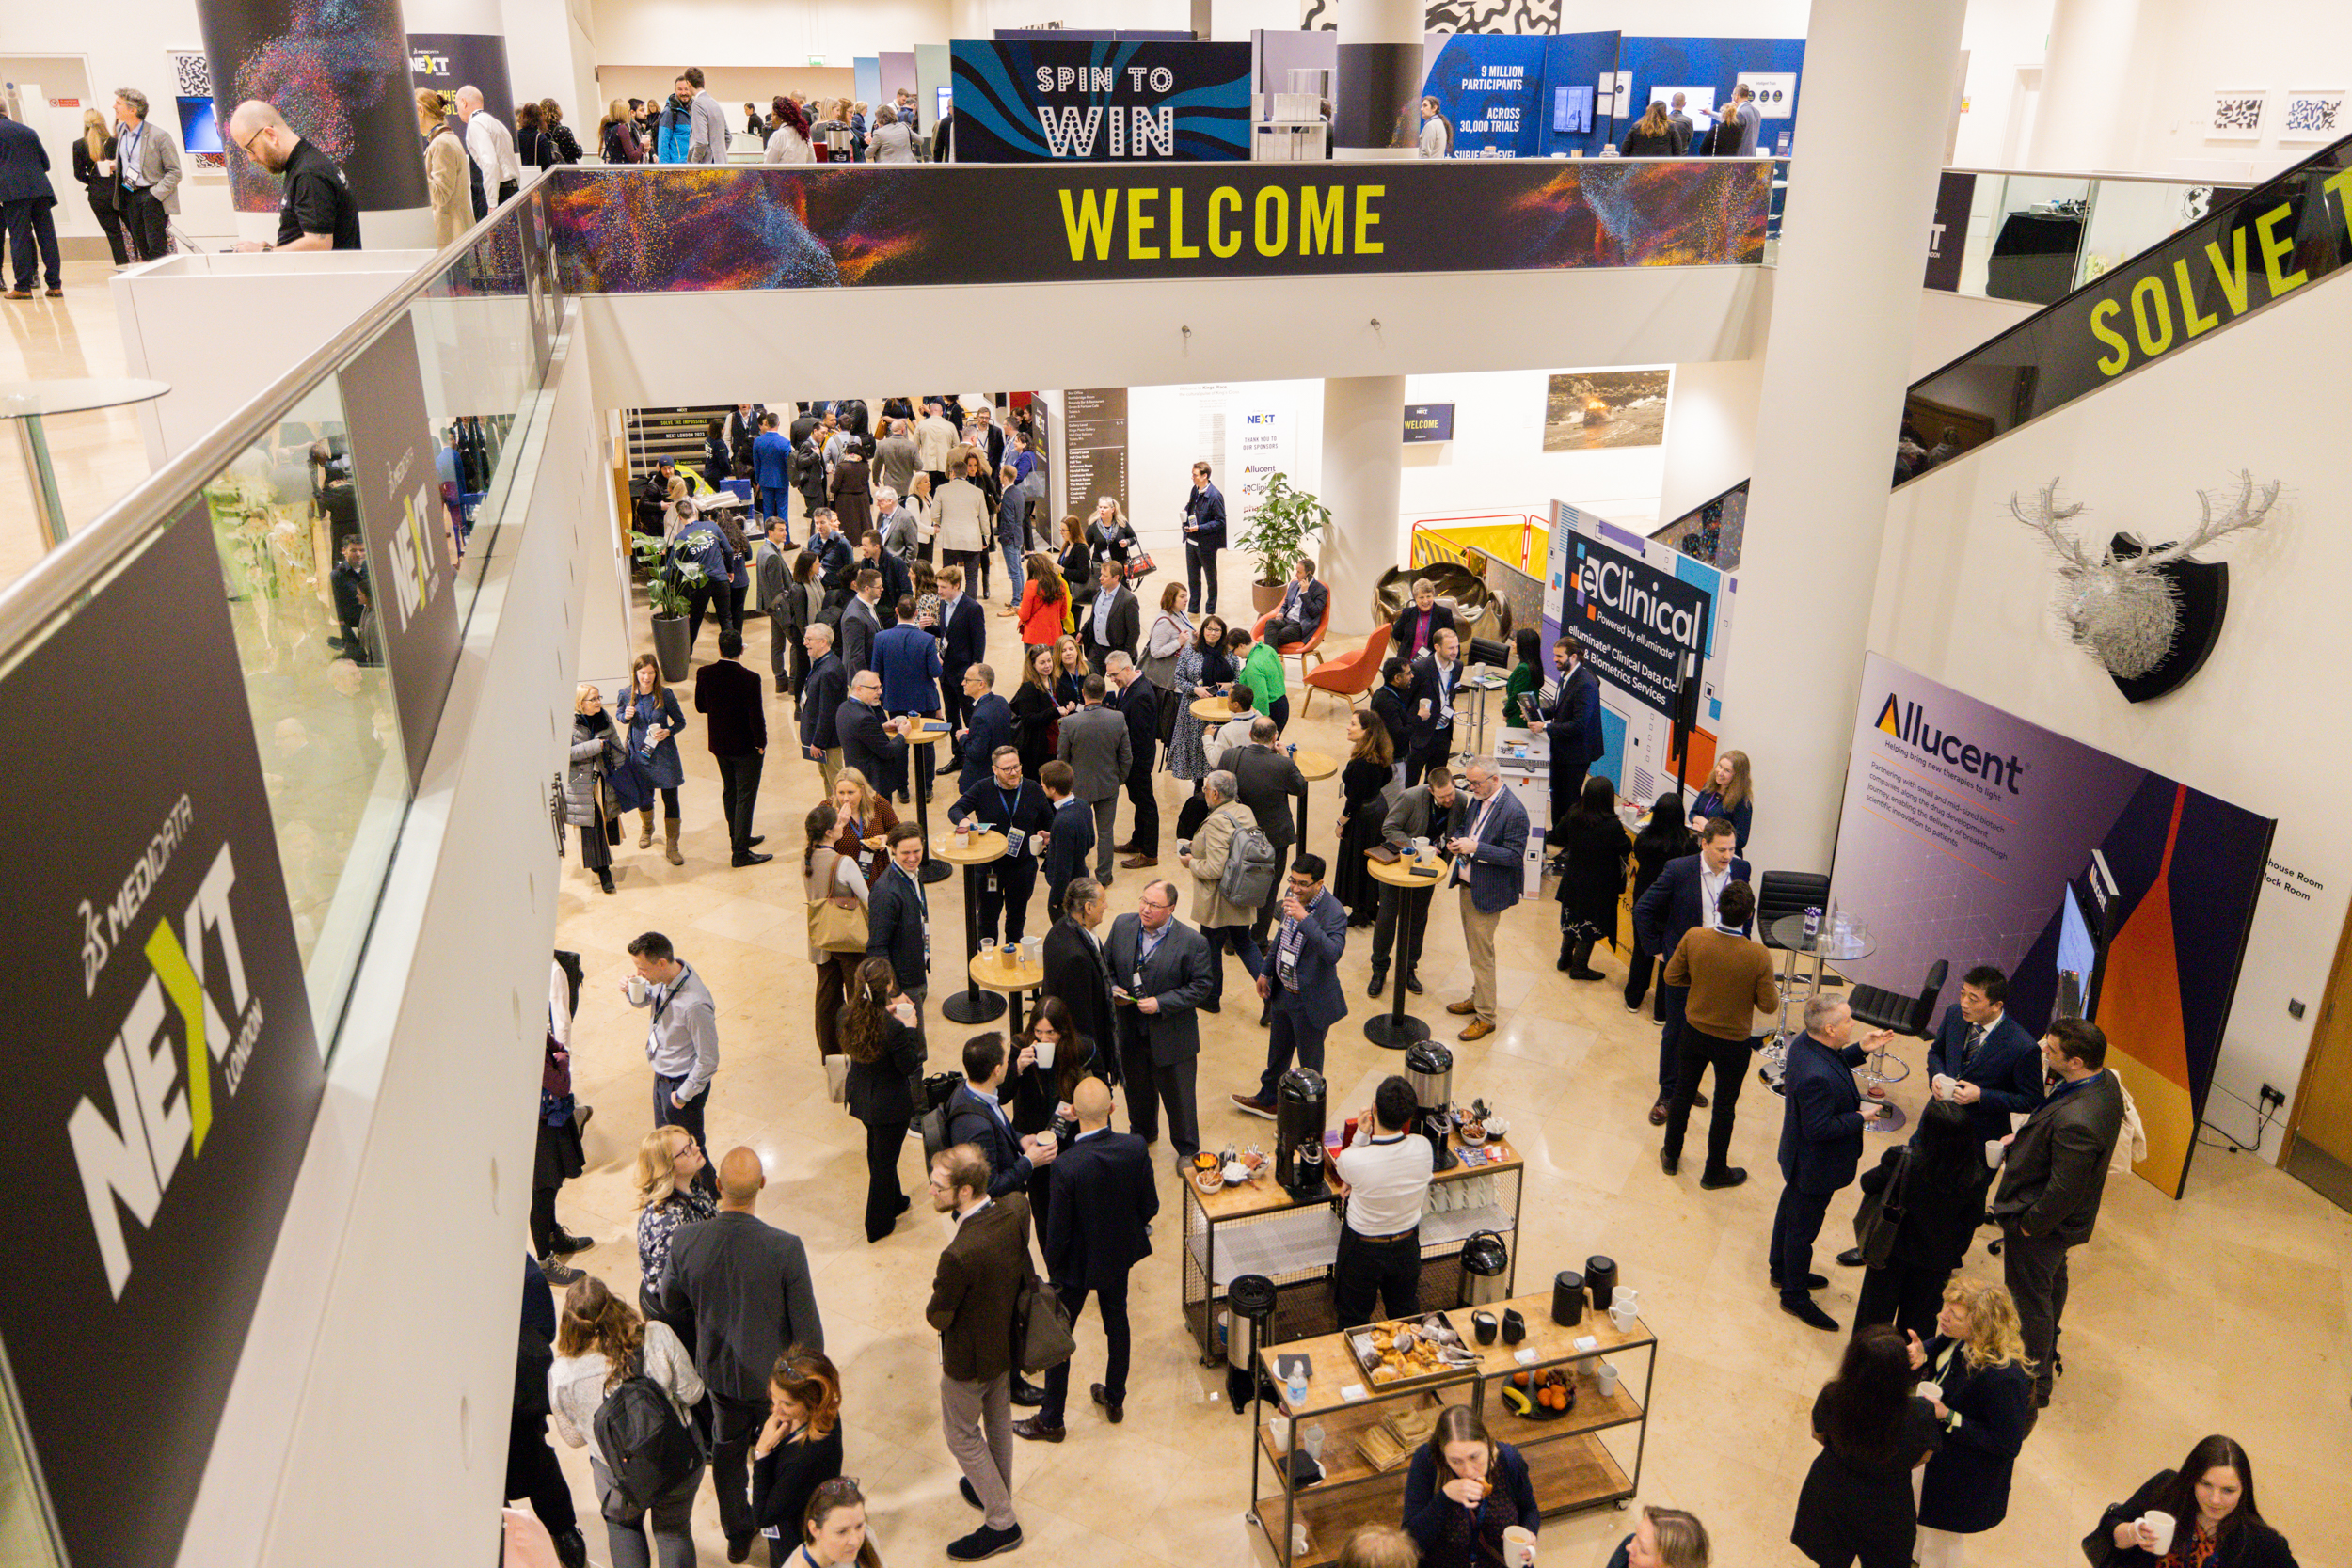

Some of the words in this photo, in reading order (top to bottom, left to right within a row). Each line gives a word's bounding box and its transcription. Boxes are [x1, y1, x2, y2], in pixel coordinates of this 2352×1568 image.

[409, 55, 449, 74] NEXT
[1036, 66, 1113, 92] SPIN
[1128, 67, 1173, 92] TO
[1462, 79, 1523, 90] PARTICIPANTS
[1481, 66, 1487, 77] 9
[1489, 66, 1524, 77] MILLION
[1037, 106, 1174, 157] WIN
[1460, 121, 1489, 134] 30,000
[1491, 121, 1520, 132] TRIALS
[1487, 108, 1521, 119] ACROSS
[1058, 185, 1385, 261] WELCOME
[2090, 202, 2308, 376] SOLVE
[1247, 414, 1275, 424] NEXT
[1404, 420, 1438, 429] WELCOME
[389, 483, 435, 634] NEXT
[690, 539, 715, 555] STAFF
[1581, 558, 1702, 649] eClinical
[1597, 611, 1626, 635] Powered
[1626, 626, 1636, 642] by
[1584, 649, 1589, 660] &
[1590, 652, 1631, 685] Biometrics
[1632, 677, 1666, 705] Services
[1612, 648, 1640, 673] Clinical
[1641, 664, 1661, 685] Data
[1885, 740, 1908, 758] Helping
[1910, 752, 1926, 767] bring
[1928, 762, 1942, 773] new
[1943, 768, 1974, 789] therapies
[1976, 784, 1983, 793] to
[1984, 788, 2001, 803] light
[1866, 794, 1891, 812] scientific
[1892, 808, 1924, 828] innovation
[1925, 824, 1931, 832] to
[1932, 829, 1958, 847] patients
[1867, 783, 1890, 800] journey,
[1891, 796, 1916, 814] enabling
[1918, 809, 1928, 819] the
[1929, 814, 1953, 833] delivery
[1963, 830, 2008, 860] breakthrough
[1869, 773, 1900, 793] companies
[1901, 789, 1918, 803] along
[1919, 797, 1929, 808] the
[1930, 804, 1945, 817] drug
[1946, 811, 1988, 838] development
[1872, 761, 1902, 783] Partnering
[1903, 777, 1916, 789] with
[1918, 786, 1934, 798] small
[1934, 794, 1946, 805] and
[1948, 800, 1979, 821] mid-sized
[1980, 813, 2005, 834] biotech
[108, 793, 193, 946] MEDIDATA
[2263, 872, 2282, 888] lock
[2284, 882, 2310, 901] Room
[2267, 858, 2294, 877] house
[2297, 871, 2324, 890] Room
[67, 840, 250, 1304] NEXT
[225, 998, 264, 1098] LONDON
